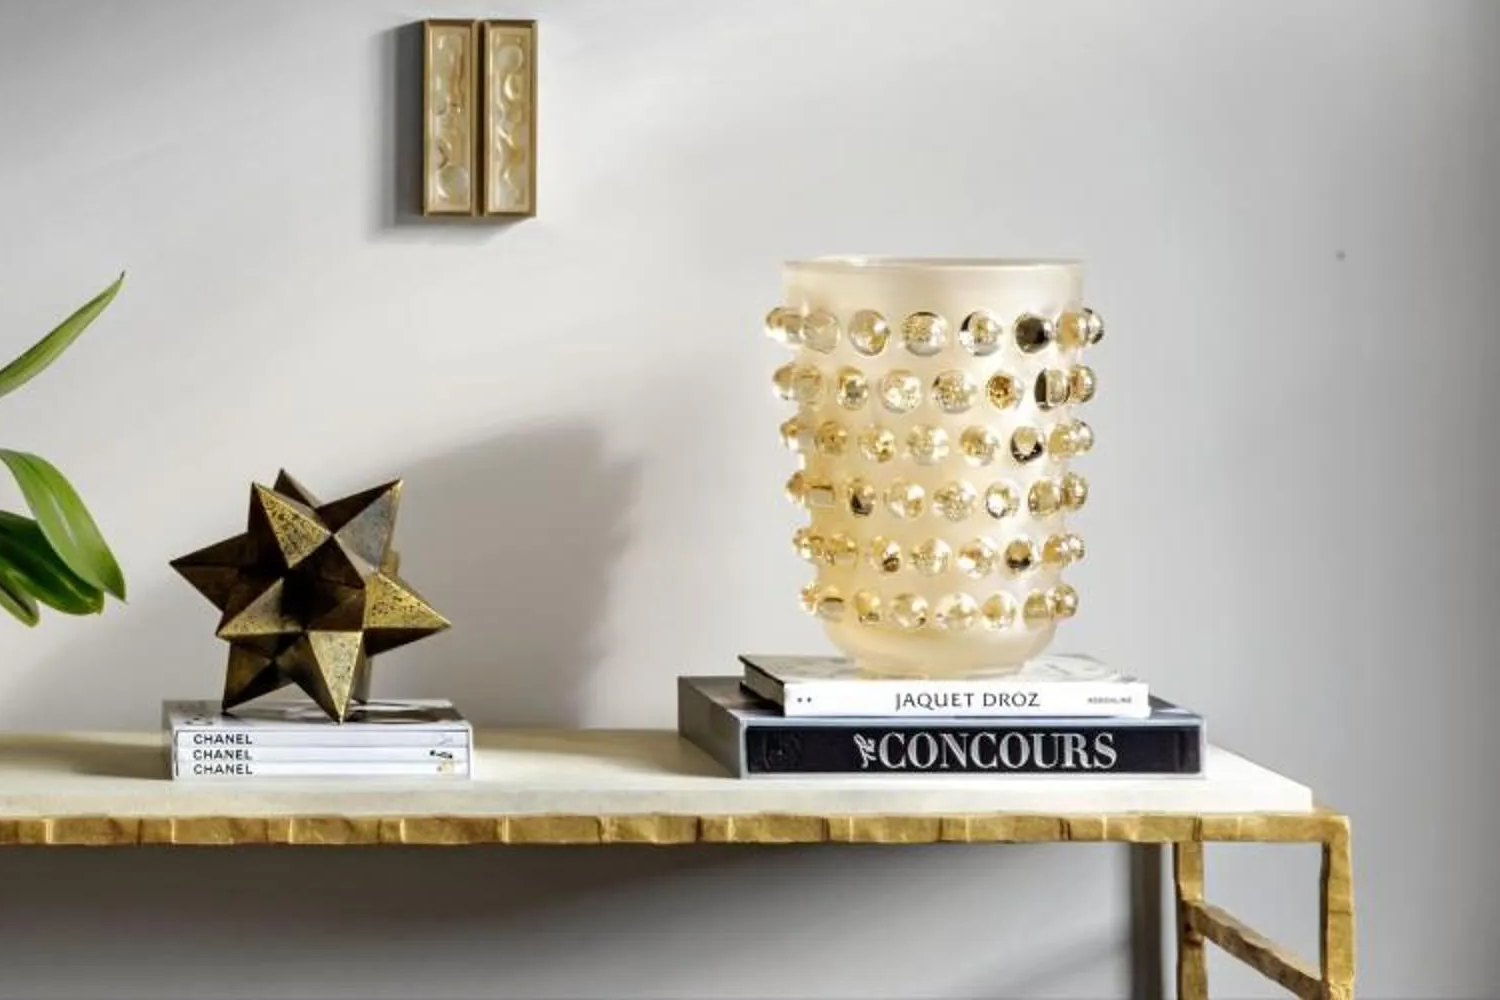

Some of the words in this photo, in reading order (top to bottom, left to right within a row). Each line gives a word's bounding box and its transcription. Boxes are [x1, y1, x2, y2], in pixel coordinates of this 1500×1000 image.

[895, 692, 975, 711] JAQUET
[983, 692, 1041, 707] DROZ
[193, 733, 253, 745] CHANEL
[192, 749, 253, 761] CHANEL
[878, 731, 1118, 769] CONCOURS
[193, 763, 253, 775] CHANEL
